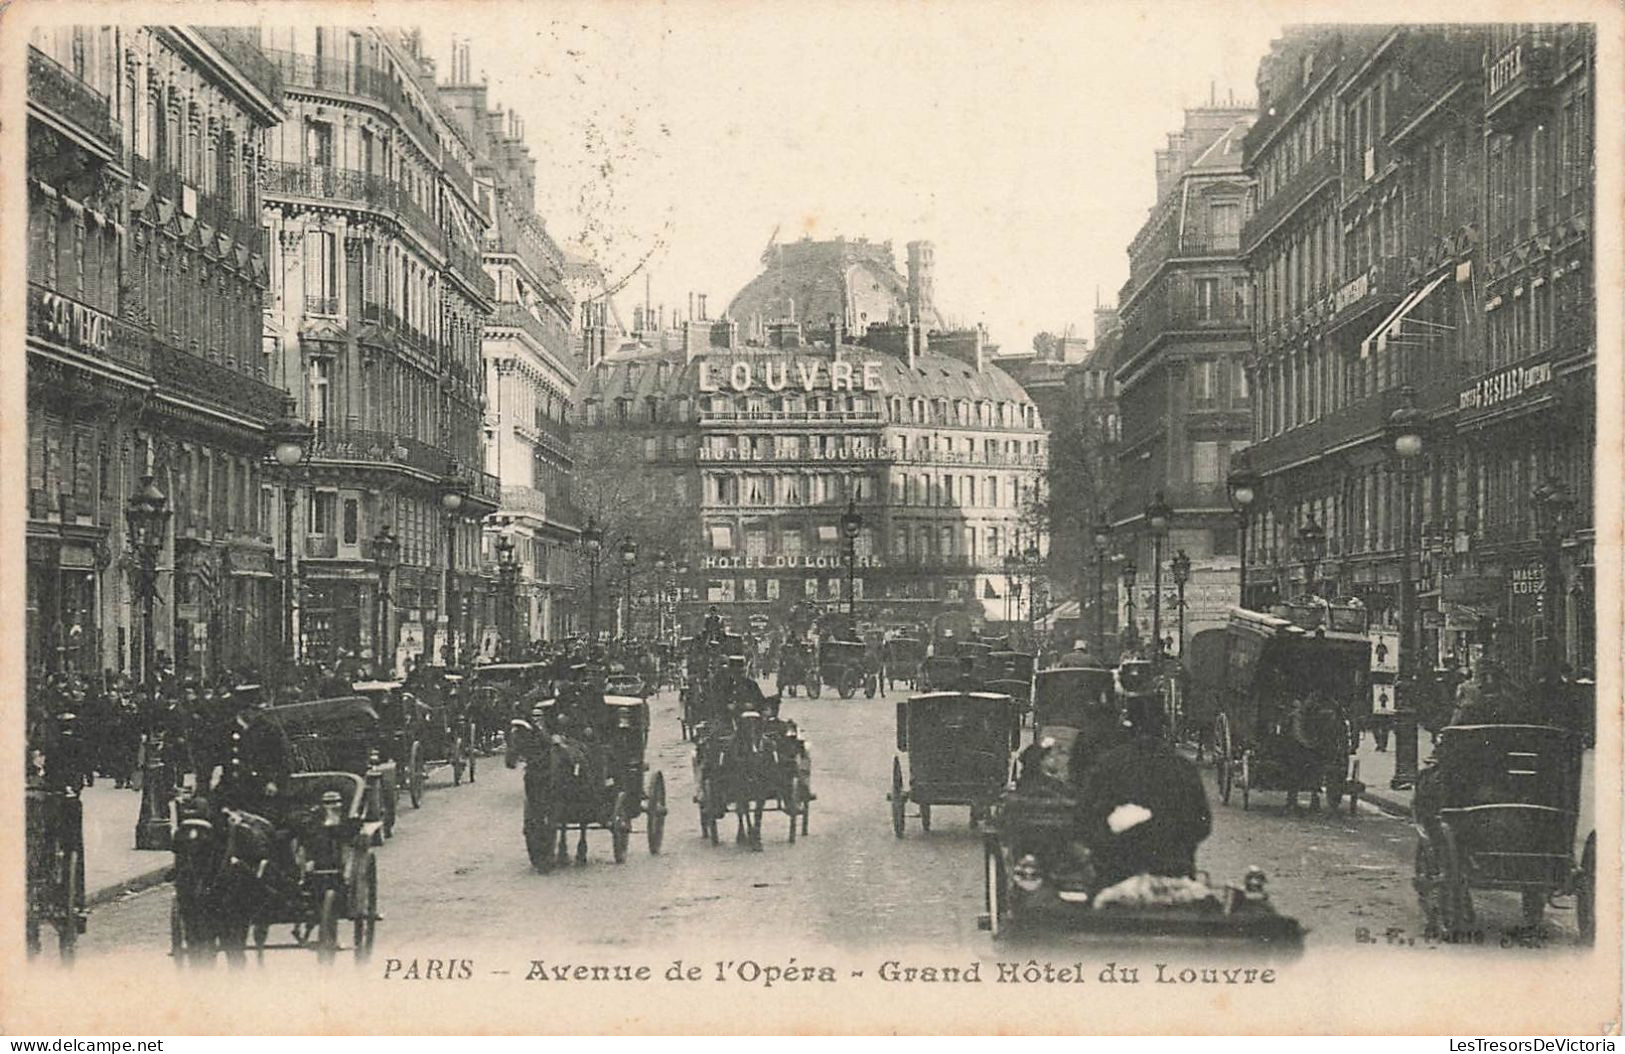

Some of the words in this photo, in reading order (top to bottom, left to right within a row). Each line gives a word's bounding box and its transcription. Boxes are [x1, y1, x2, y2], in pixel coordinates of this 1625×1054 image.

[699, 361, 883, 392] LOUVRE
[699, 446, 764, 461] HOTEL
[775, 447, 800, 461] DU
[813, 446, 889, 461] LOUVRE
[706, 556, 770, 569] HOTEL
[776, 556, 798, 569] DU
[805, 555, 882, 569] LOURE
